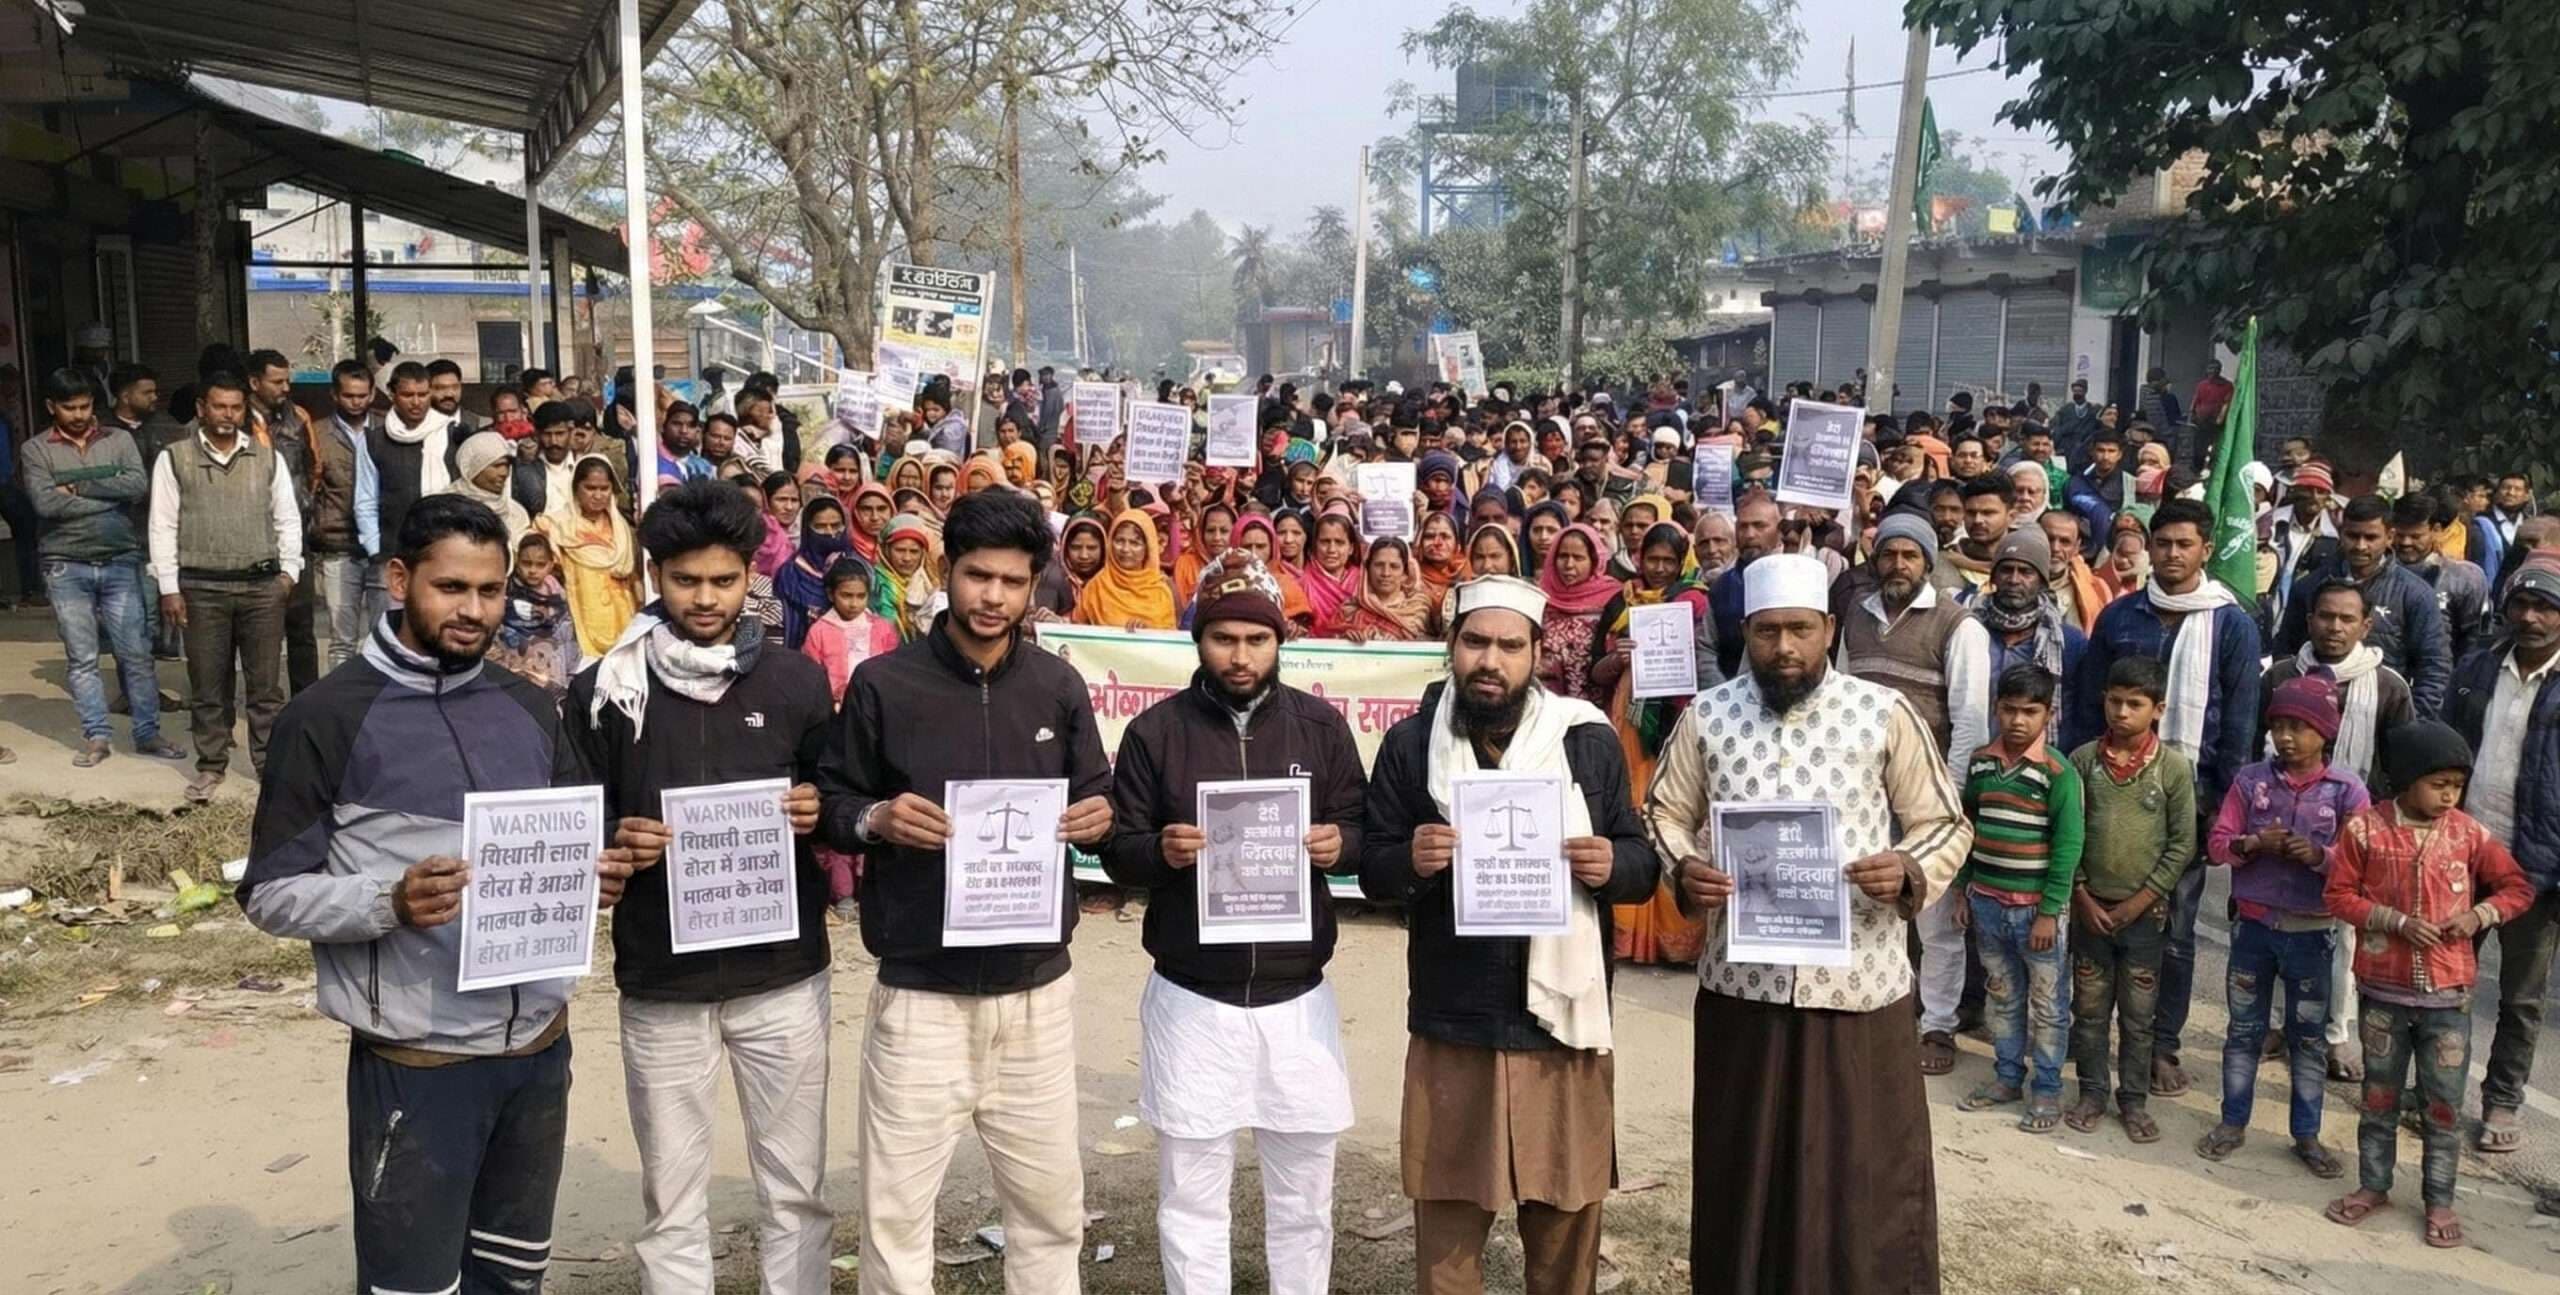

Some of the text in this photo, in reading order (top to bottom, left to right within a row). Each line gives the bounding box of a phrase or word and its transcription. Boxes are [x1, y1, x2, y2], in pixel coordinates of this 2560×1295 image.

[489, 811, 586, 835] WARNING
[683, 800, 774, 824] WARNING
[735, 879, 752, 898] के
[530, 902, 549, 926] के
